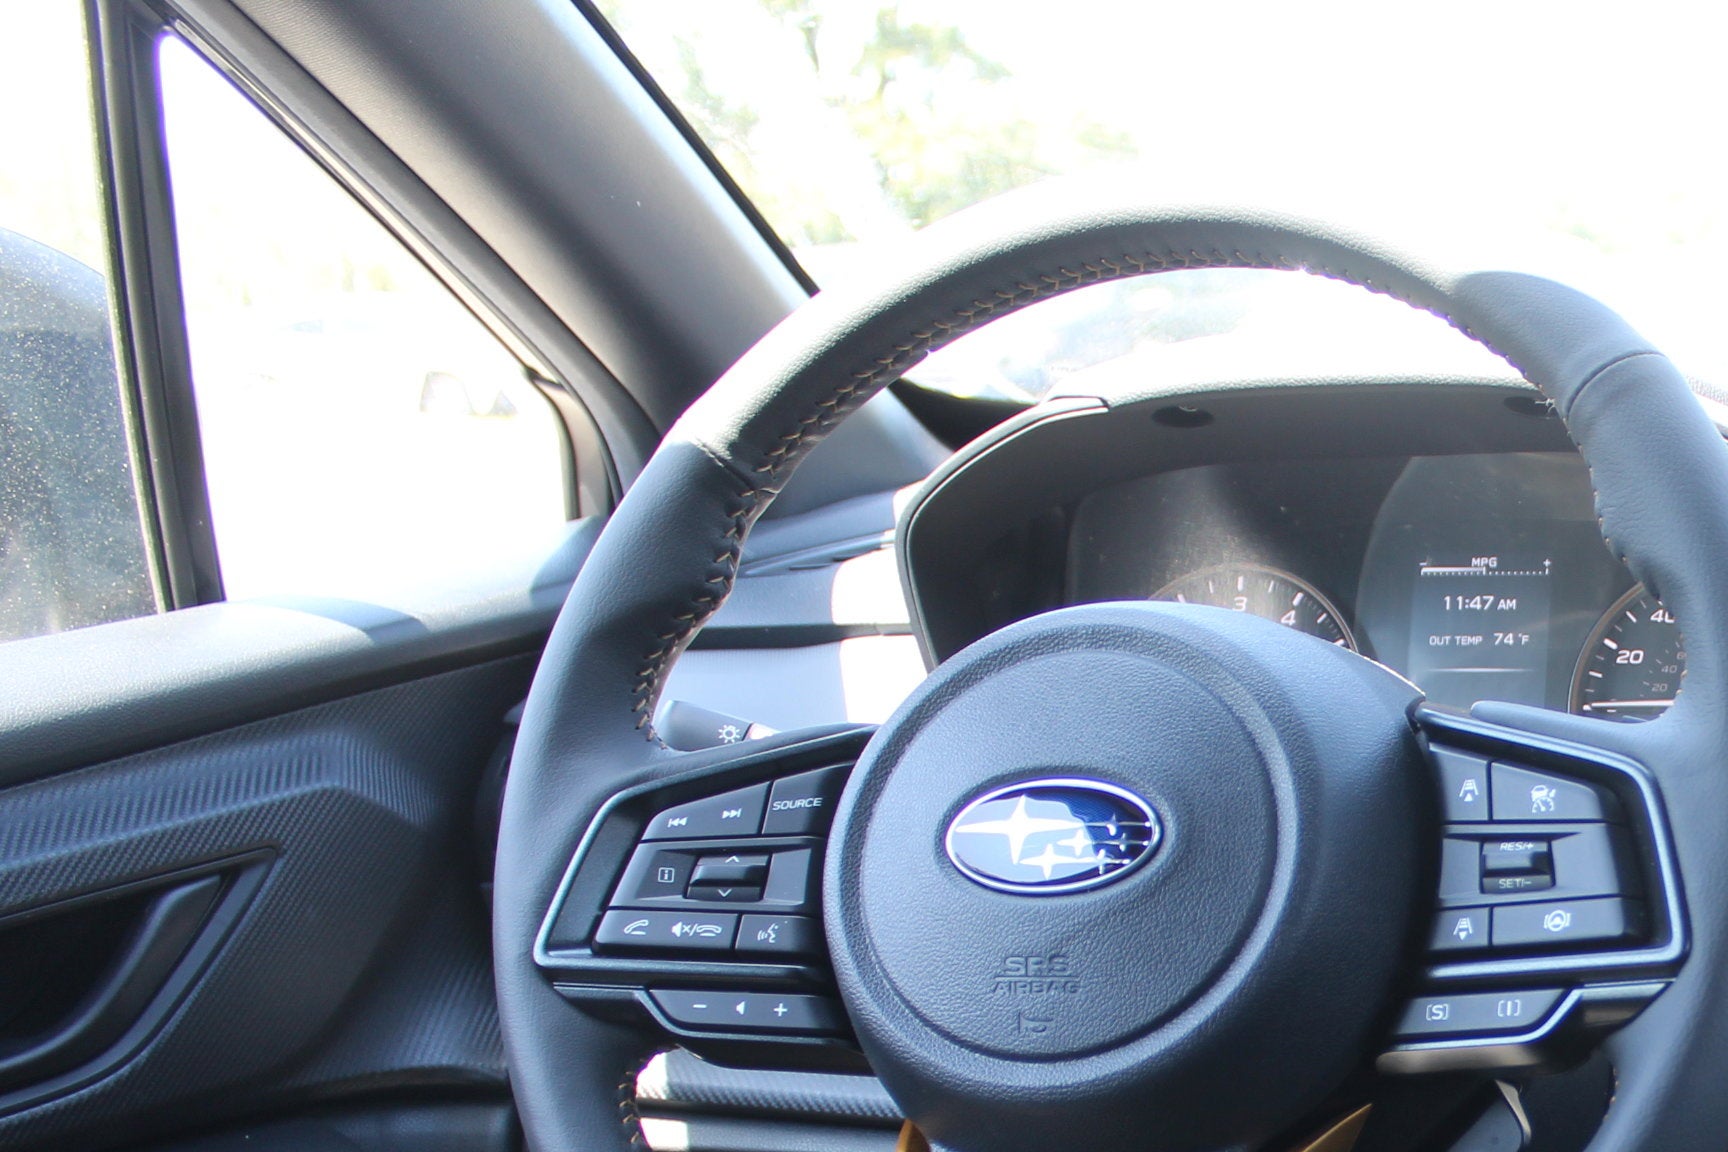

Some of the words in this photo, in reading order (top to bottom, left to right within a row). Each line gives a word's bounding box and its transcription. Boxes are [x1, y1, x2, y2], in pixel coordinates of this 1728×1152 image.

[1471, 557, 1498, 568] MPG
[1232, 596, 1248, 612] 3
[1444, 595, 1495, 611] 11:47
[1497, 599, 1517, 611] AM
[1280, 610, 1297, 626] 4
[1429, 635, 1451, 646] OUT
[1454, 635, 1483, 646] TEMP
[1493, 632, 1514, 646] 74
[1615, 650, 1644, 665] 20
[772, 797, 822, 811] SOURCE
[1004, 955, 1070, 976] SRS
[991, 980, 1080, 995] AIRBAG
